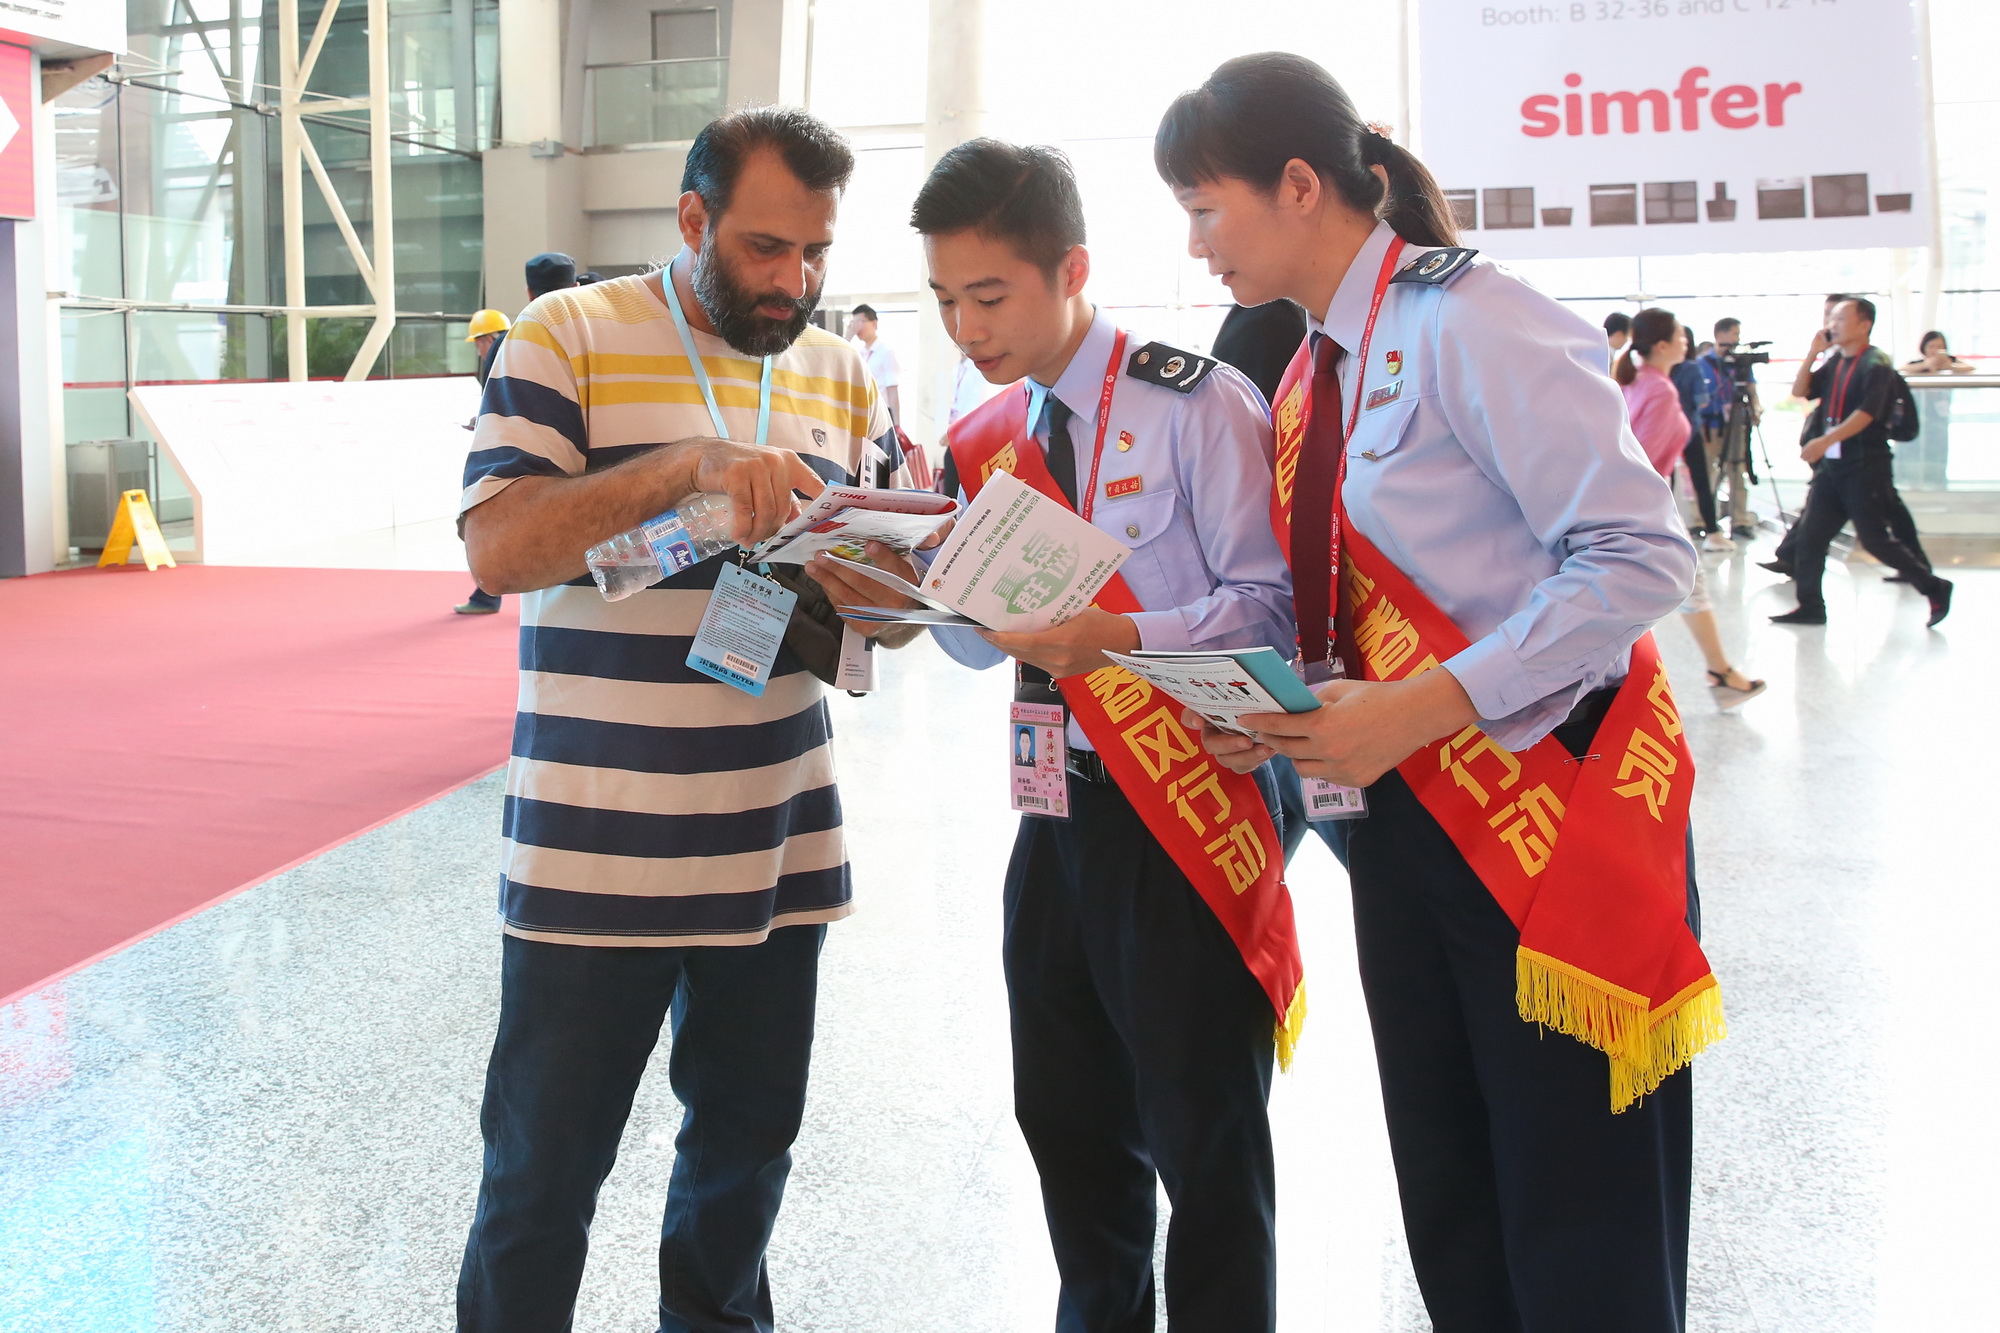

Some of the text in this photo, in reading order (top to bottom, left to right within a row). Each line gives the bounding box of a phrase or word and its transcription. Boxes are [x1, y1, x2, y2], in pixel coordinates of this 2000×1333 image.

[1482, 5, 1560, 26] Booth:
[1570, 3, 1586, 22] B
[1595, 0, 1669, 20] 32-36
[1520, 66, 1802, 138] simfer
[1050, 711, 1062, 721] 126
